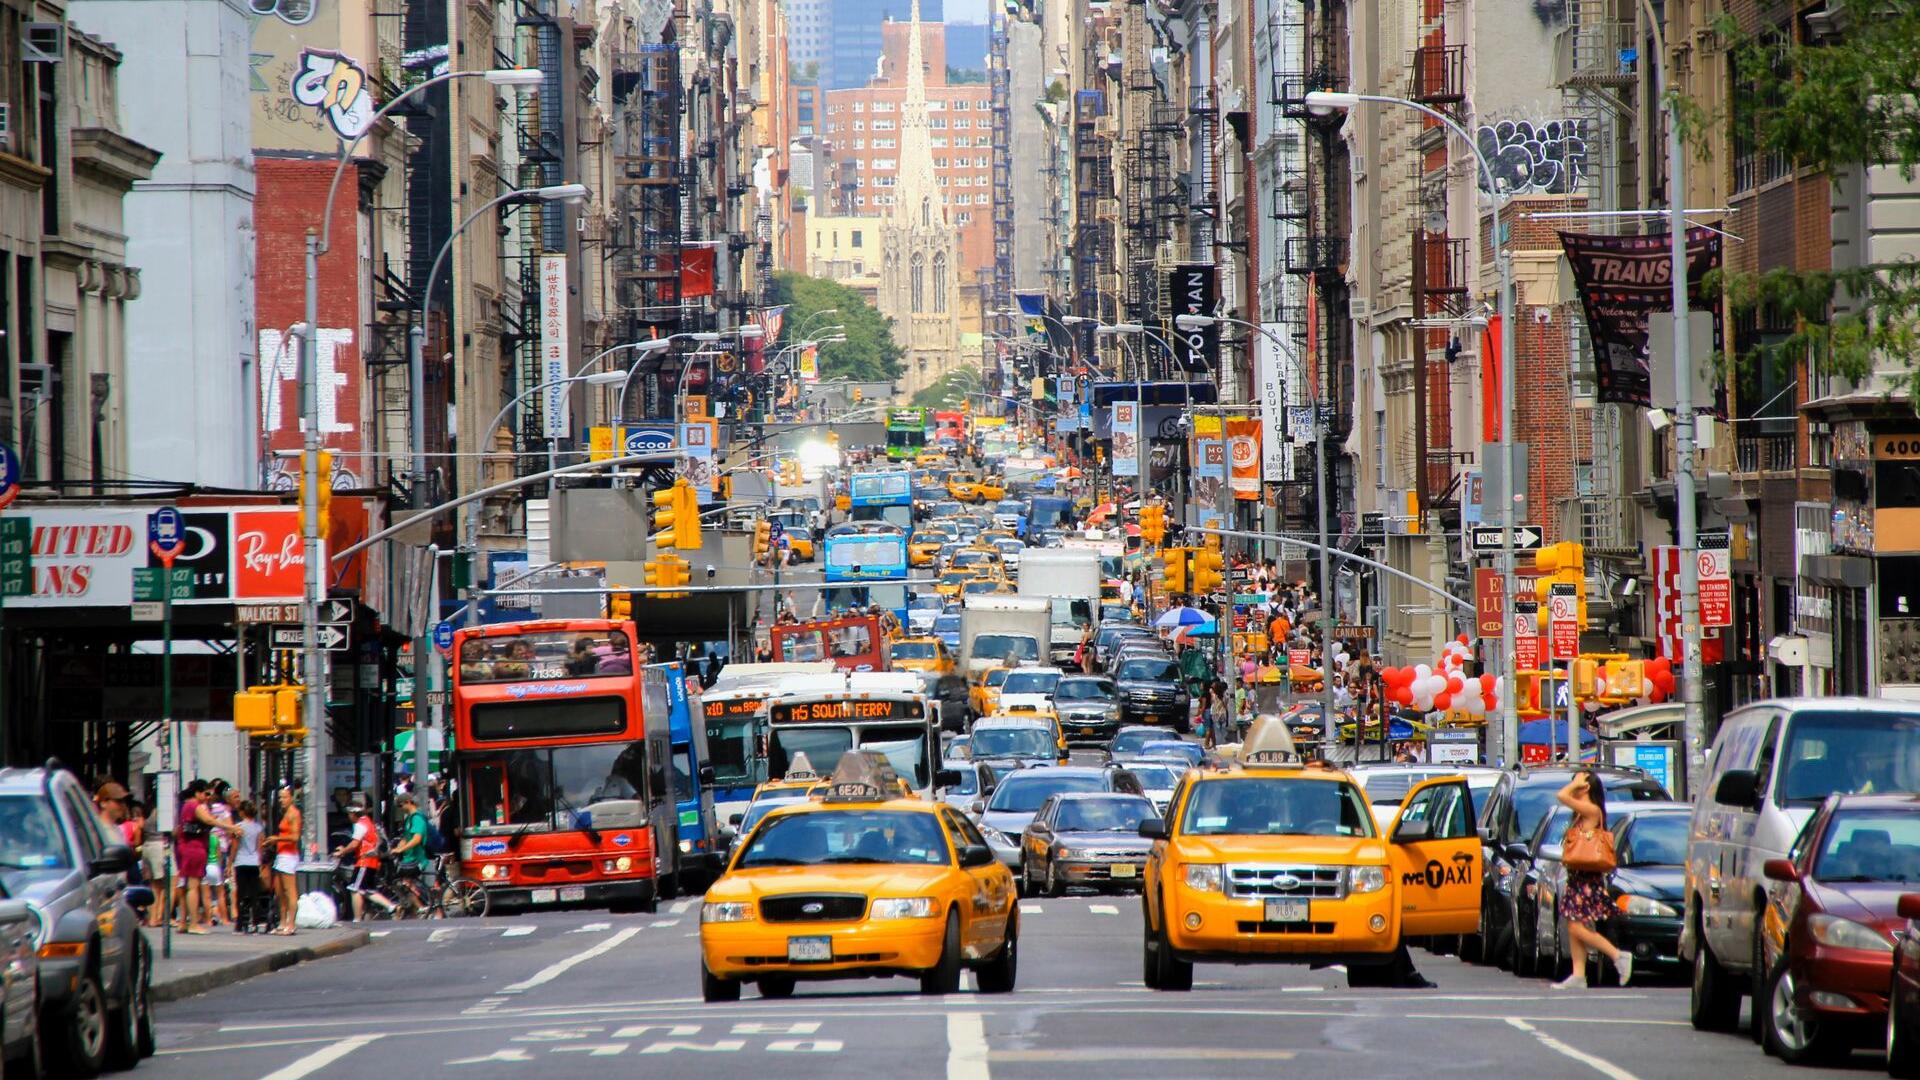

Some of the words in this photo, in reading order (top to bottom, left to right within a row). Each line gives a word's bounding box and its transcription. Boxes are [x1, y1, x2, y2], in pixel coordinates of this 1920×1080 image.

[1591, 256, 1696, 283] TRANST
[1885, 441, 1920, 455] 400
[1479, 533, 1498, 543] ONE
[1483, 597, 1504, 613] LU
[238, 606, 279, 621] WALKER
[285, 605, 298, 621] ST
[281, 631, 303, 641] ONE
[1335, 629, 1359, 638] CANAL
[1361, 629, 1372, 638] ST
[532, 668, 563, 678] 71336
[791, 704, 808, 720] M5
[812, 703, 851, 719] SOUTH
[855, 702, 892, 717] FERRY
[1260, 752, 1284, 763] 9L89
[839, 784, 865, 796] 6E20
[1402, 872, 1425, 885] NYC
[1427, 861, 1472, 888] TAXI
